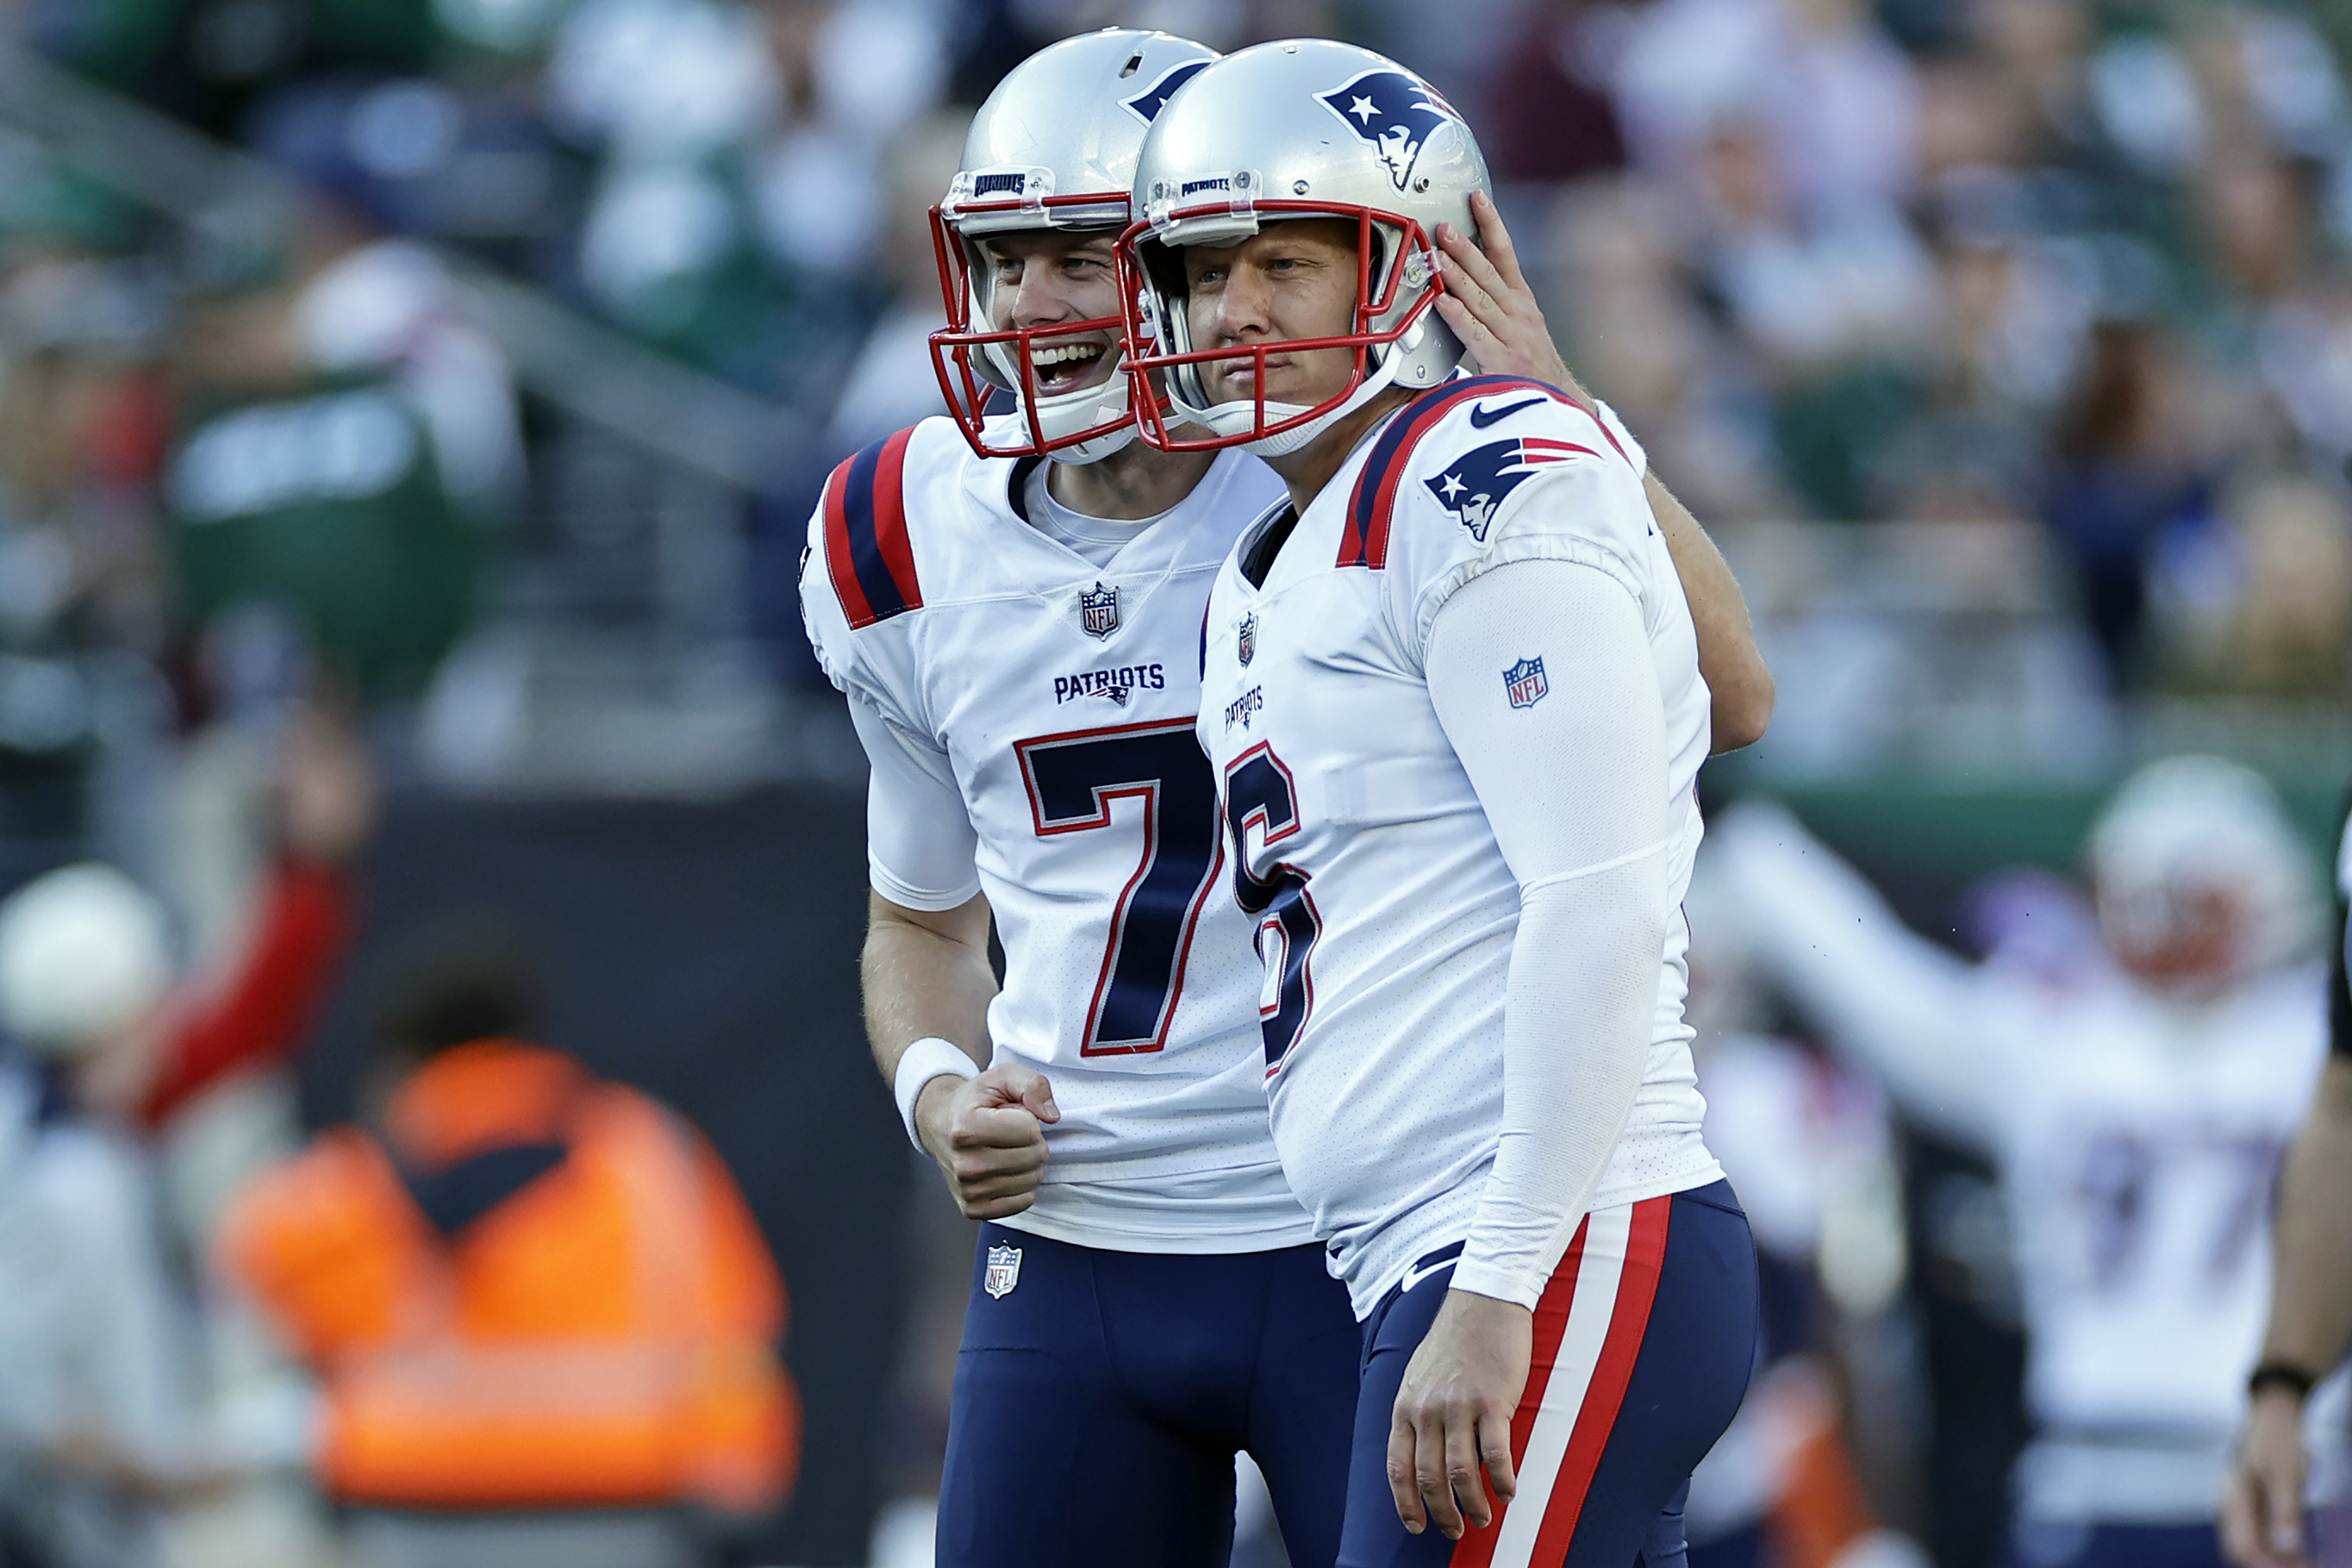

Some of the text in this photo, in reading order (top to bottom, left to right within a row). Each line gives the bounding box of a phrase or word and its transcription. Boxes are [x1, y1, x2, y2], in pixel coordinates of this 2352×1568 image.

[974, 174, 1025, 198] PATRIOTS
[1182, 178, 1230, 196] PATRIOTS
[1086, 607, 1114, 629] NFL
[1054, 664, 1165, 705] PATRIOTS
[1510, 676, 1544, 704] NFL
[1225, 685, 1263, 734] PATRIOTS
[1014, 716, 1224, 1057] 7
[989, 1269, 1010, 1288] NFL
